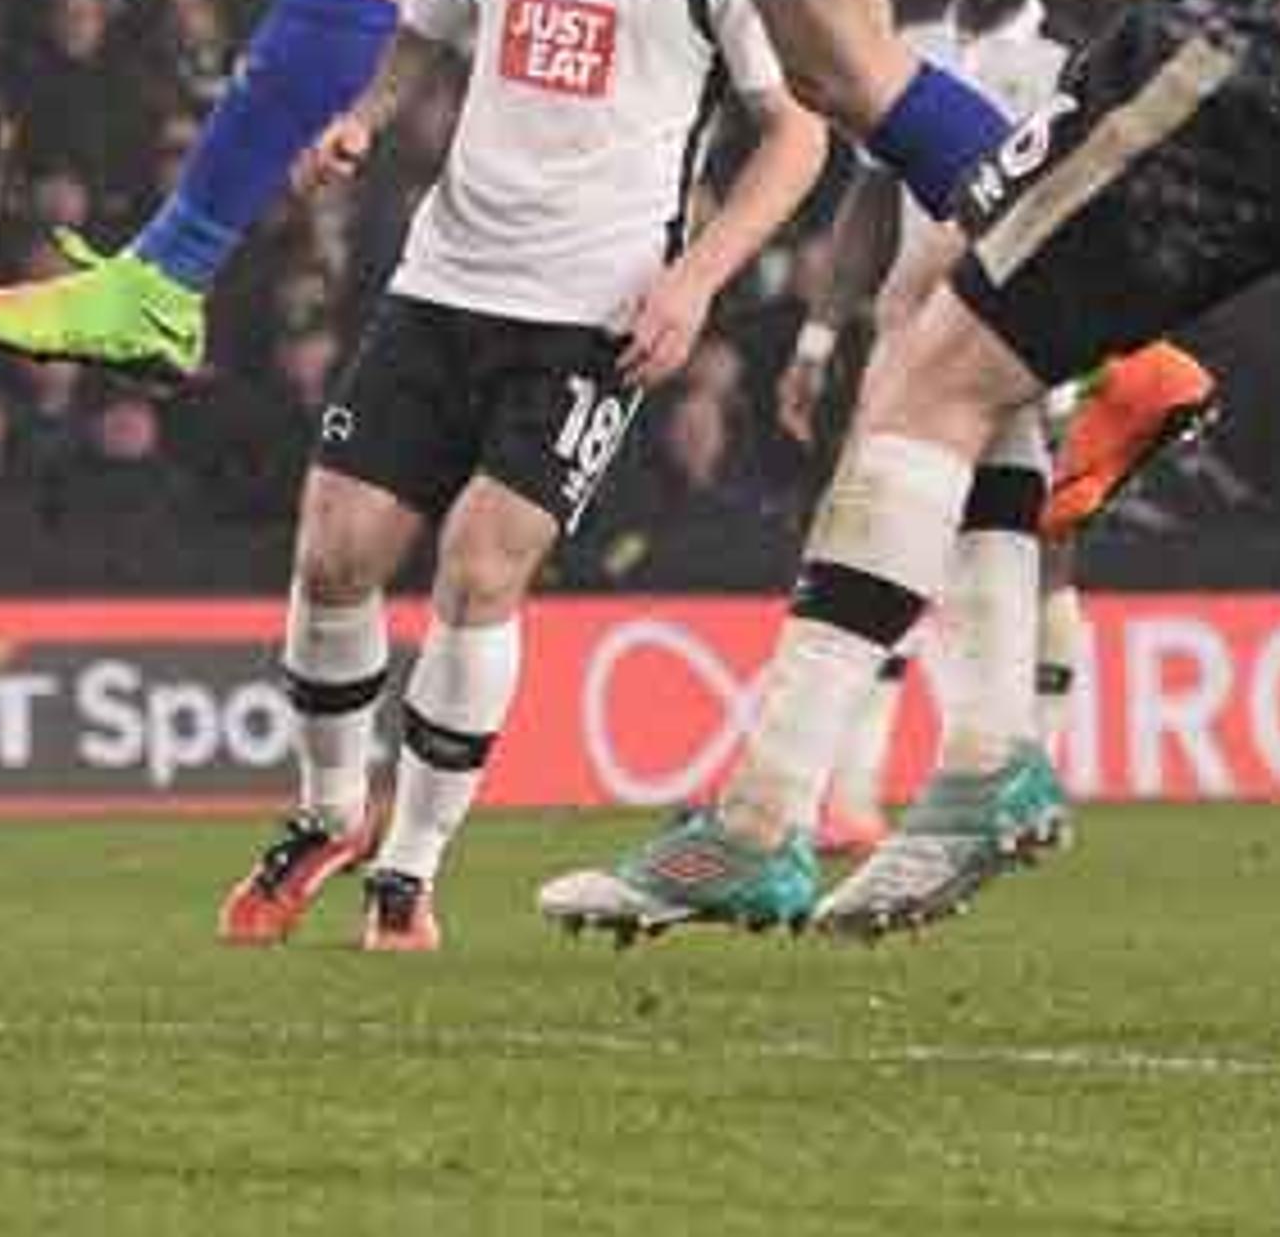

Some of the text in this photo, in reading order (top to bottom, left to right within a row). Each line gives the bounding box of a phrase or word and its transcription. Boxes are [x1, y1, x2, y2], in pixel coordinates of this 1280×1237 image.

[510, 2, 604, 50] JUST
[527, 45, 602, 88] EAT
[555, 376, 622, 477] 18
[75, 660, 299, 788] Spo
